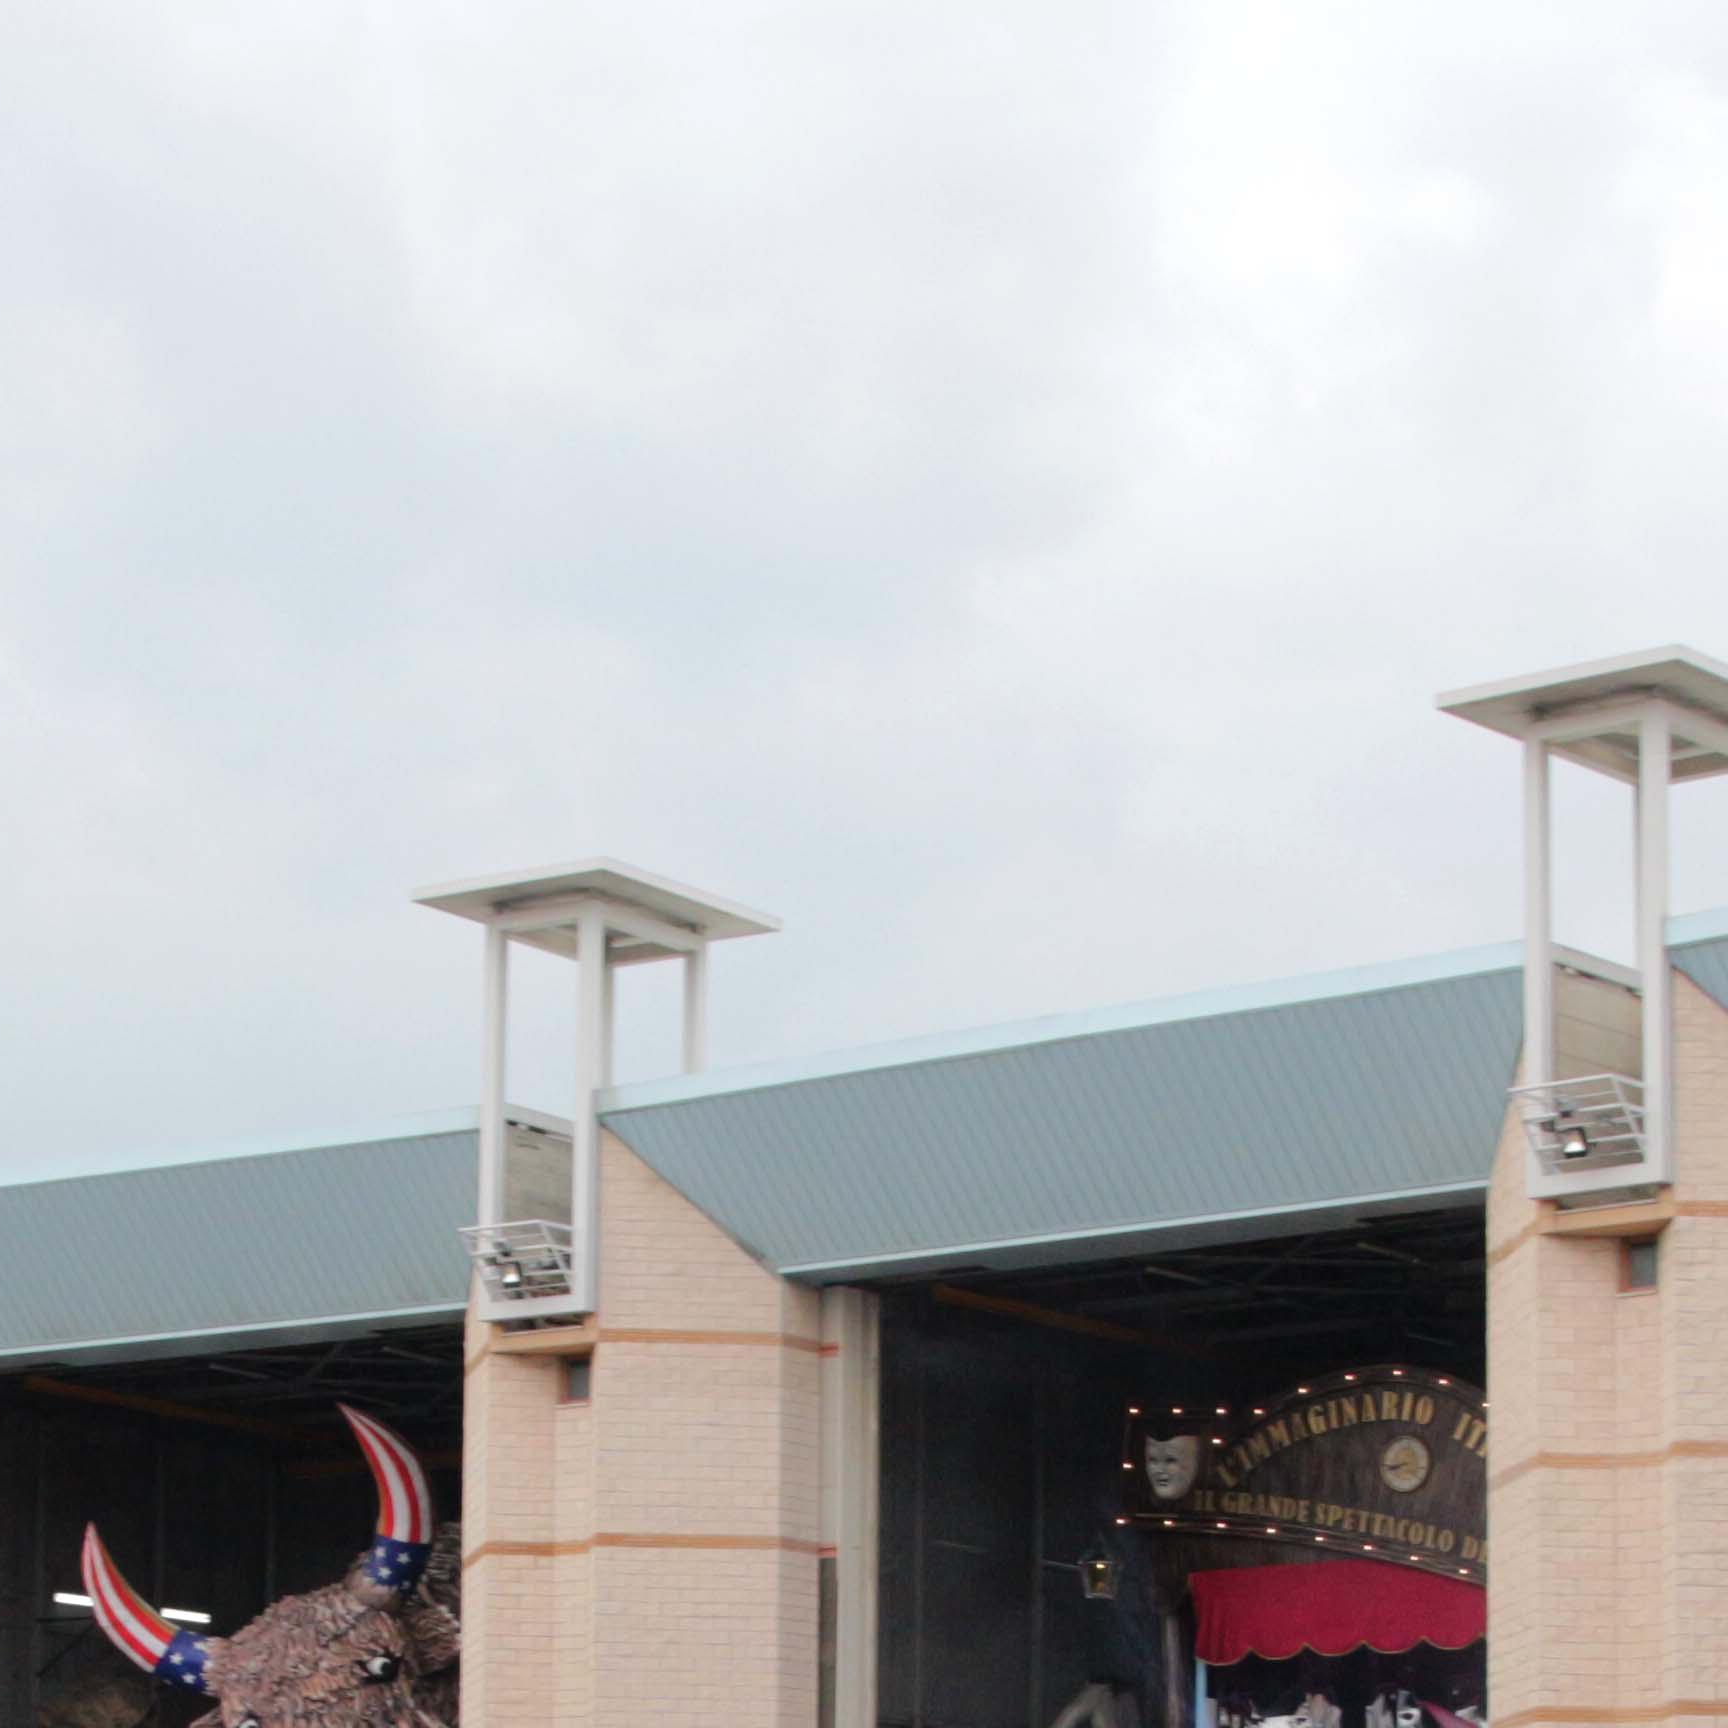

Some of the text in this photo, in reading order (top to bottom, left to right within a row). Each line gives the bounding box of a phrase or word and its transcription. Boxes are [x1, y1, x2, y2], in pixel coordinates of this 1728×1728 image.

[1215, 1391, 1435, 1488] L'IMMAGINARIO
[1221, 1491, 1312, 1524] GRANDE
[1315, 1503, 1455, 1553] SPETTACOLO
